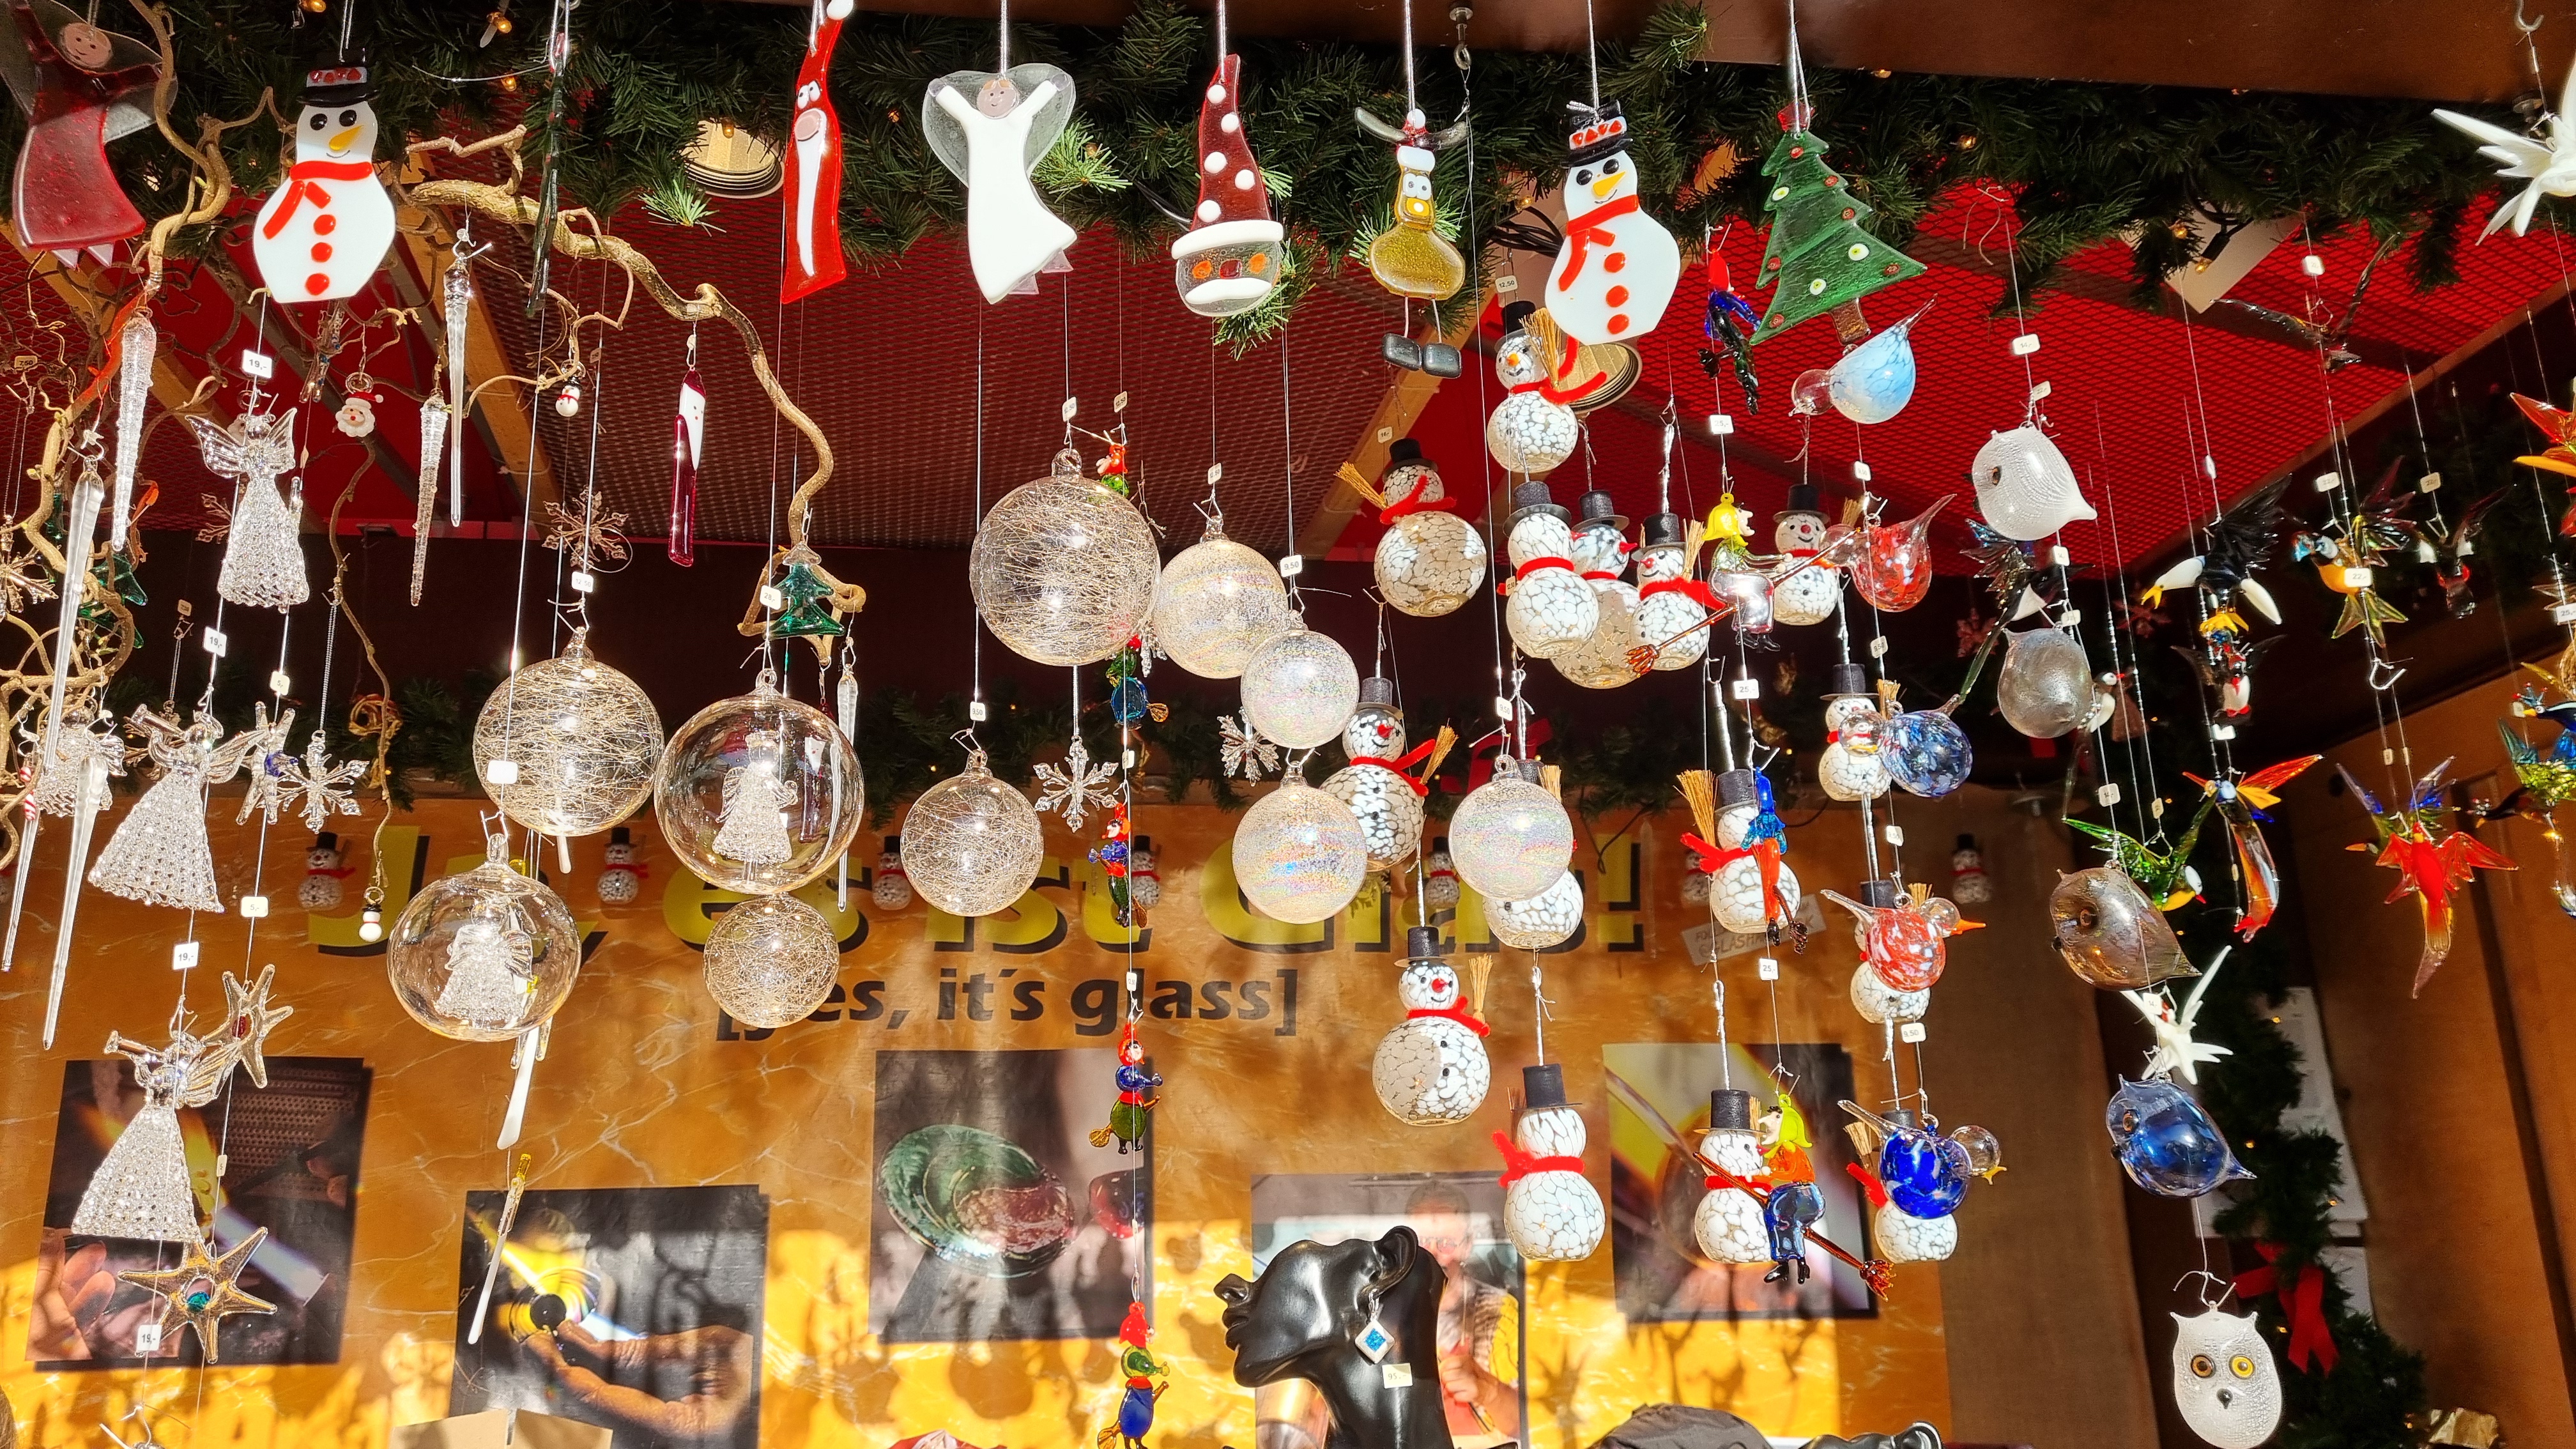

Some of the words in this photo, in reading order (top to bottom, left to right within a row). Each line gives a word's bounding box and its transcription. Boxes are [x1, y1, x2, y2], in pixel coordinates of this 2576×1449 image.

[1498, 279, 1515, 288] 12,50
[249, 358, 267, 370] 19,-
[764, 592, 776, 602] 28,-
[210, 636, 222, 648] 19,-
[1739, 686, 1756, 694] 25,-
[250, 903, 260, 912] 5,-
[178, 952, 194, 962] 19,-
[1762, 964, 1775, 974] 25,-
[1070, 968, 1298, 1038] glass]
[141, 1333, 157, 1344] 19,-
[1388, 1372, 1407, 1381] 95.-
